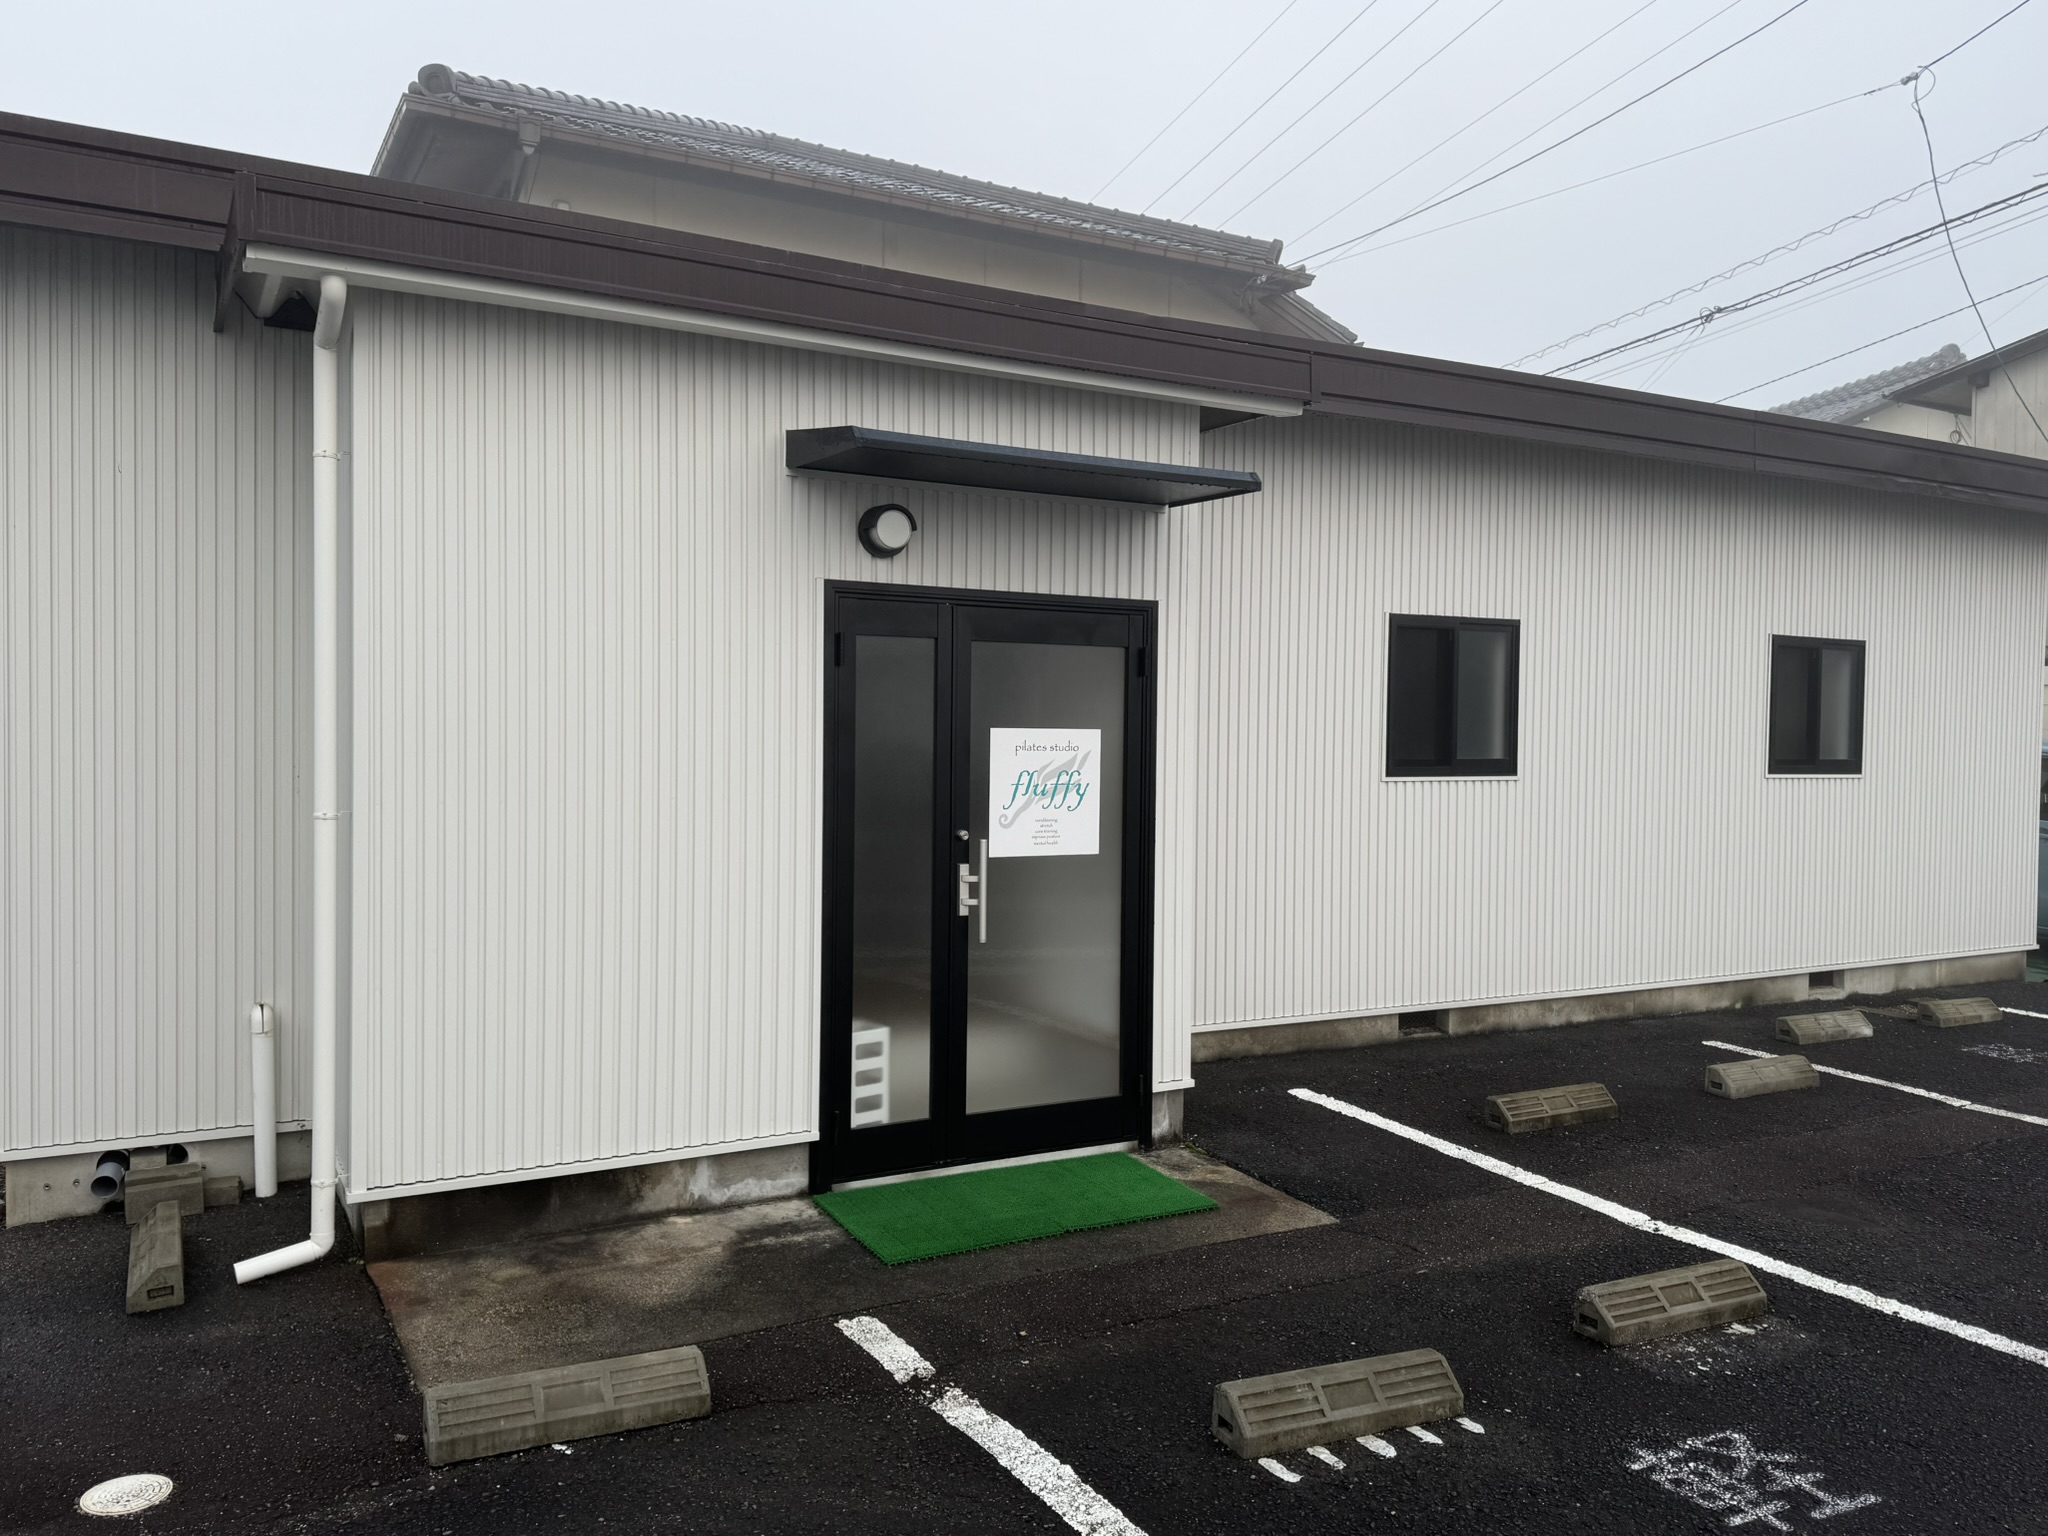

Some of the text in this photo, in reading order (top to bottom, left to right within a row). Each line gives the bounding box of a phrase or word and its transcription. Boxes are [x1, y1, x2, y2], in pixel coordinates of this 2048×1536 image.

[1015, 739, 1080, 756] pilates studio
[1002, 769, 1090, 812] fluffy
